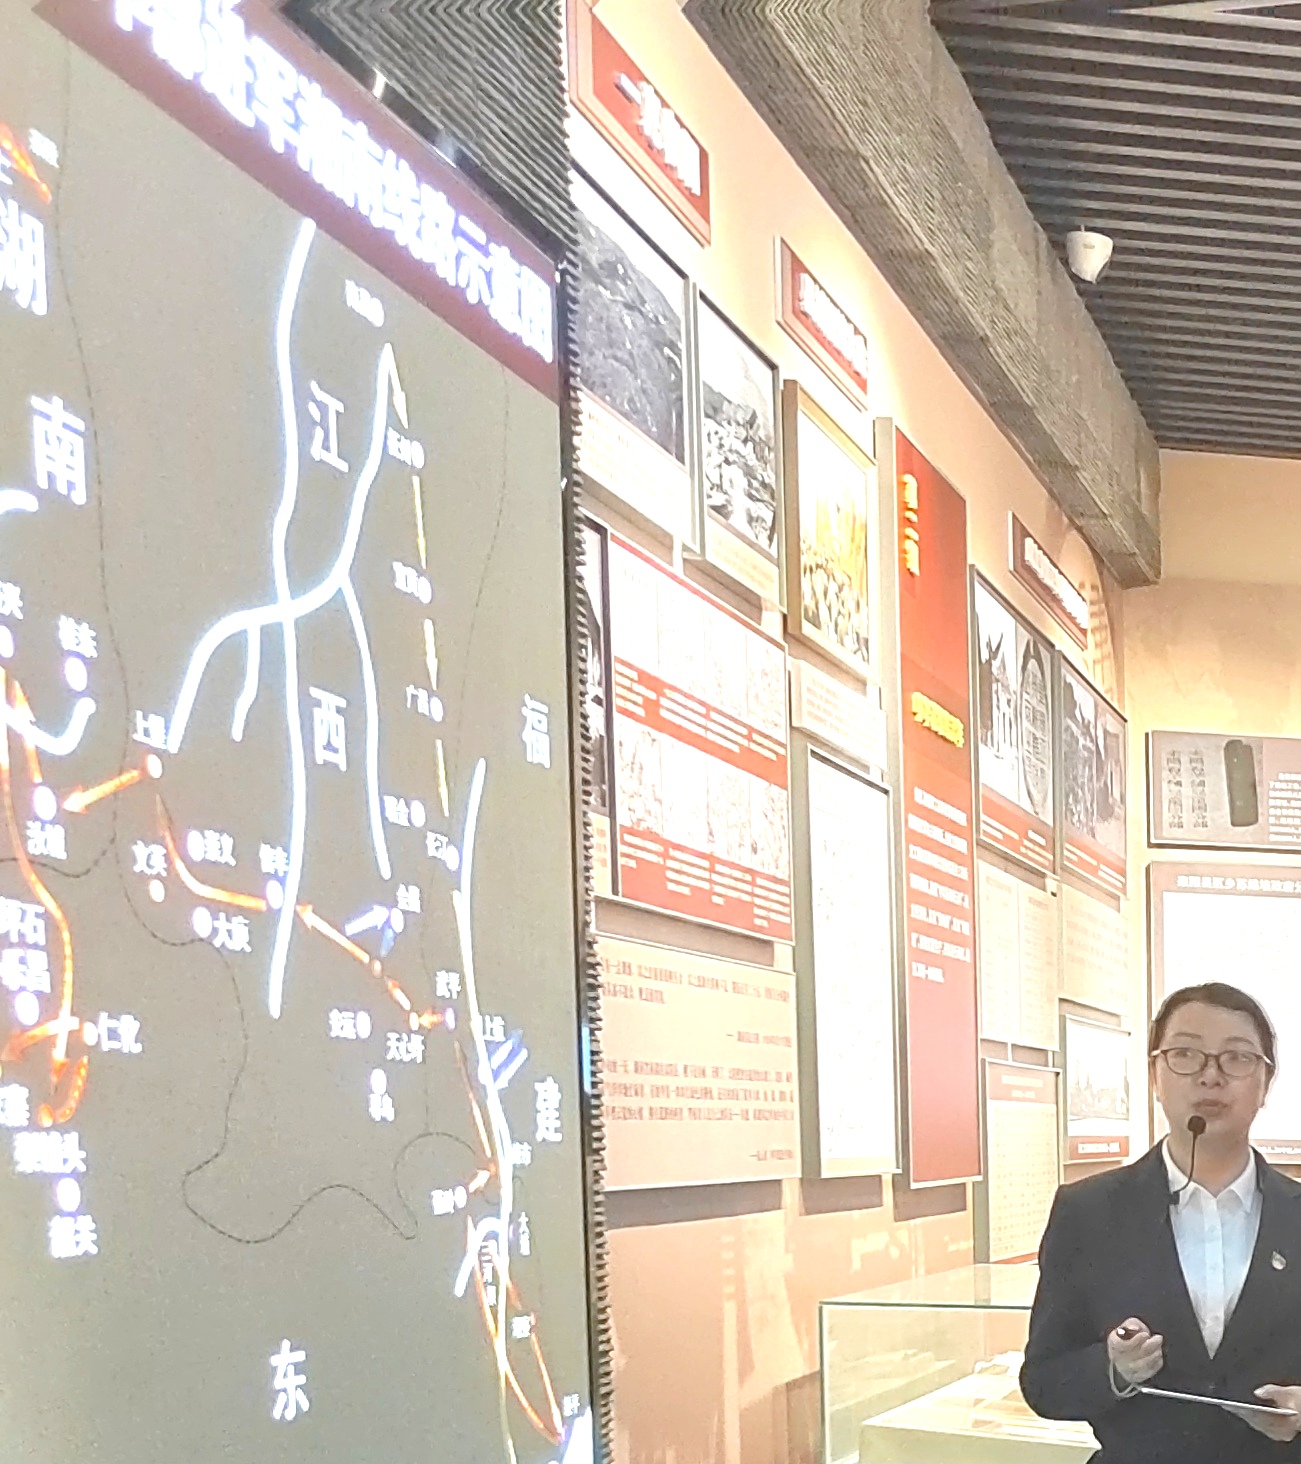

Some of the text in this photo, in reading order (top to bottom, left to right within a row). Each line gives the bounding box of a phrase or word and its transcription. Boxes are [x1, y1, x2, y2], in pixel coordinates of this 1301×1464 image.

[31, 395, 86, 504] 南
[308, 380, 349, 473] 江
[309, 687, 347, 771] 西
[522, 694, 551, 768] 福
[270, 1339, 309, 1421] 东
